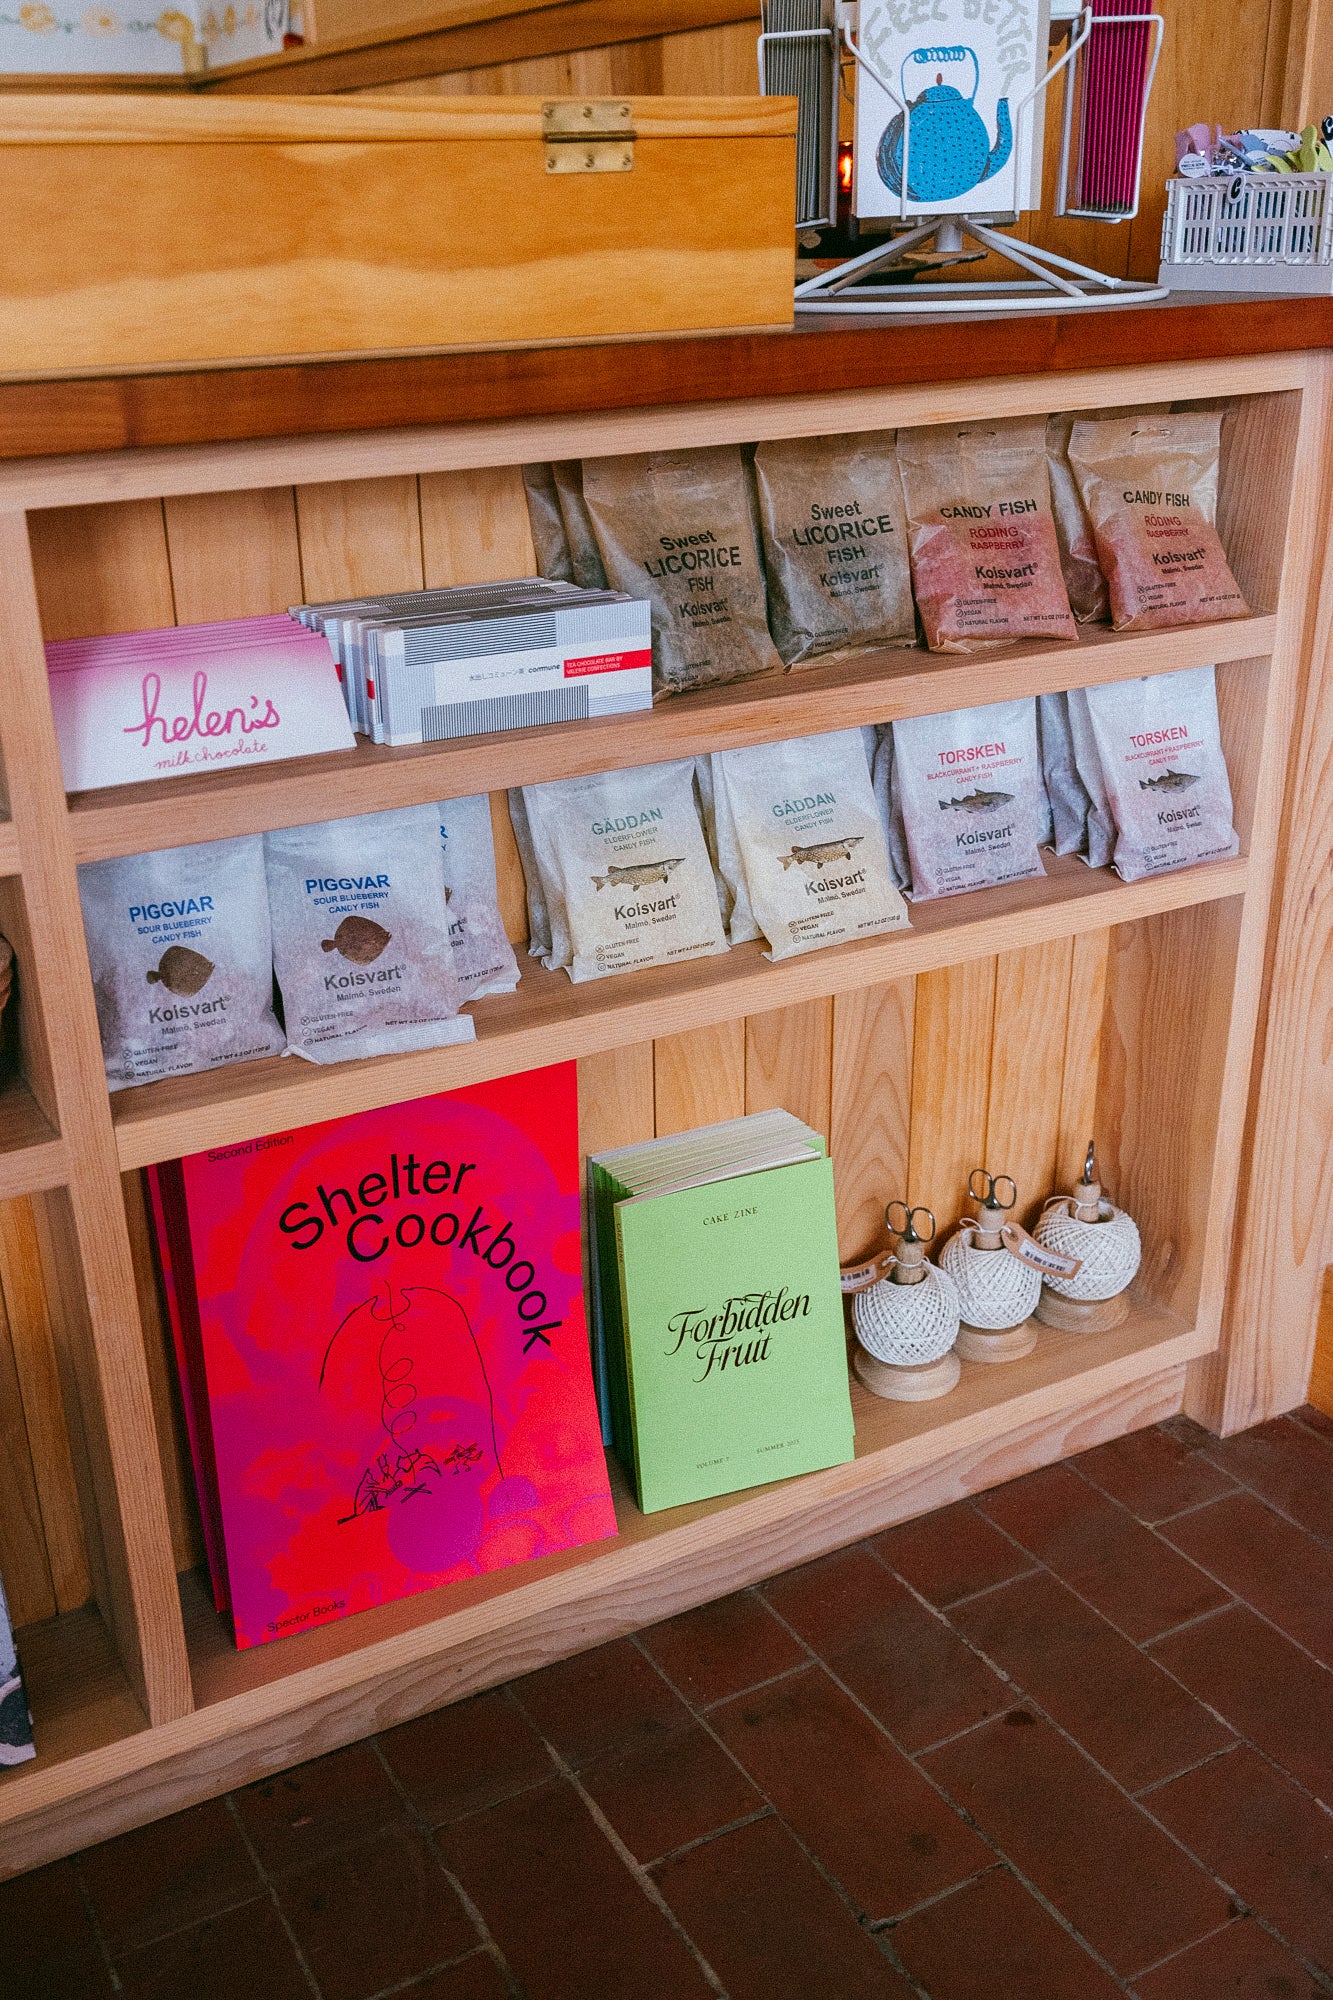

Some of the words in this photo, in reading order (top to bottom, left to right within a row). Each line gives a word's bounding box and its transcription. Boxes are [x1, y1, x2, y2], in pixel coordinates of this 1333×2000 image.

[1124, 491, 1162, 504] CANDY
[1166, 493, 1190, 506] FISH
[812, 501, 862, 520] Sweet
[940, 505, 992, 519] CANDY
[999, 499, 1037, 516] FISH
[1145, 514, 1182, 526] RÖDING
[793, 515, 893, 546] LICORICE
[969, 526, 1018, 538] RÖDING
[1147, 529, 1189, 538] RASPBERRY
[660, 530, 717, 550] Sweet
[970, 539, 1025, 550] RASPBERRY
[644, 546, 741, 578] LICORICE
[828, 545, 866, 565] FISH
[688, 576, 713, 592] FISH
[855, 585, 880, 594] Sweden
[528, 664, 560, 673] commune
[577, 658, 604, 666] CHOCOLATE
[587, 663, 620, 672] CONFECTIONS
[123, 670, 279, 747] helen's
[1130, 726, 1187, 748] TORSKEN
[153, 748, 192, 770] milk
[192, 738, 267, 763] chocolate
[938, 742, 1006, 765] TORSKEN
[927, 766, 975, 780] BLACKCURRANT
[982, 758, 1022, 770] RASPBERRY
[956, 775, 976, 784] CANDY
[772, 792, 836, 817] GÄDDAN
[591, 808, 663, 836] GÄDDAN
[785, 808, 834, 826] ELDERFLOWER
[794, 822, 817, 832] CANDY
[819, 818, 833, 826] FISH
[604, 826, 658, 845] ELDERFLOWER
[614, 842, 637, 852] CANDY
[639, 837, 655, 847] FISH
[305, 874, 391, 894] PIGGVAR
[842, 887, 866, 898] Sweden
[313, 895, 338, 906] SOUR
[340, 891, 389, 902] BLUEBERRY
[129, 895, 214, 923] PIGGVAR
[328, 905, 359, 914] CANDY
[360, 902, 380, 910] FISH
[137, 924, 161, 935] SOUR
[163, 916, 212, 931] BLUEBERRY
[652, 913, 677, 925] Sweden
[152, 932, 181, 944] CANDY
[183, 929, 202, 940] FISH
[607, 961, 632, 969] NATURAL
[633, 956, 654, 964] FLAVOR
[368, 985, 401, 997] Sweden
[194, 1017, 226, 1030] Sweden
[313, 1025, 335, 1034] VEGAN
[314, 1033, 343, 1043] NATURAL
[135, 1059, 158, 1067] VEGAN
[136, 1069, 166, 1077] NATURAL
[168, 1062, 193, 1072] FLAVOR
[208, 1143, 252, 1163] Second
[256, 1135, 294, 1151] Edition
[279, 1153, 477, 1250] Shelter
[703, 1213, 729, 1226] CAKE
[734, 1206, 759, 1218] ZINE
[346, 1206, 562, 1354] Cookbook
[664, 1286, 812, 1356] Forbidden
[692, 1332, 773, 1383] Fruit
[696, 1458, 724, 1469] VOLUME
[756, 1443, 784, 1454] SUMMER
[267, 1612, 310, 1632] Spector
[313, 1600, 345, 1617] Books
